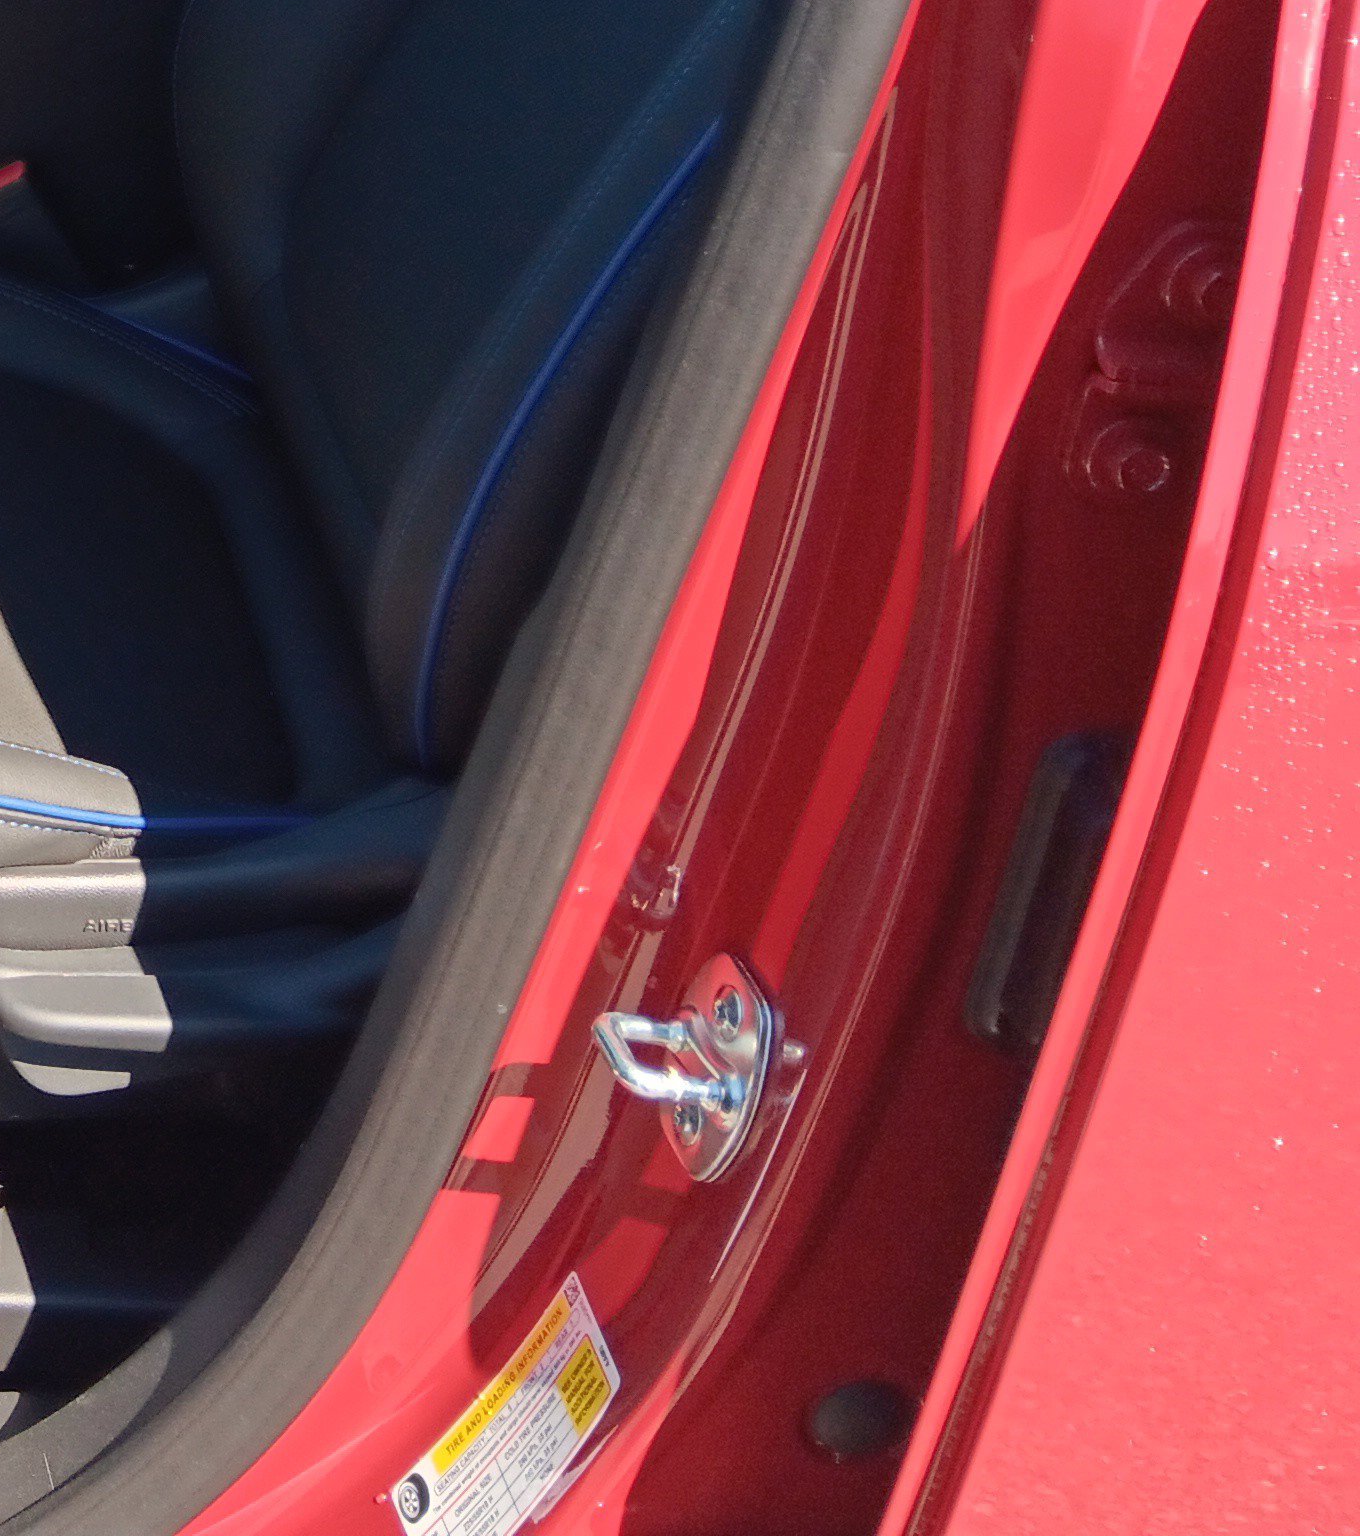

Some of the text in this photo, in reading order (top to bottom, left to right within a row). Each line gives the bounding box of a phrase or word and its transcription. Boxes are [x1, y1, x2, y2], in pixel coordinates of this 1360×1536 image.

[445, 1432, 465, 1456] TIRE
[465, 1412, 483, 1436] AND
[482, 1371, 517, 1416] LOADING
[515, 1306, 563, 1375] INFORMATION
